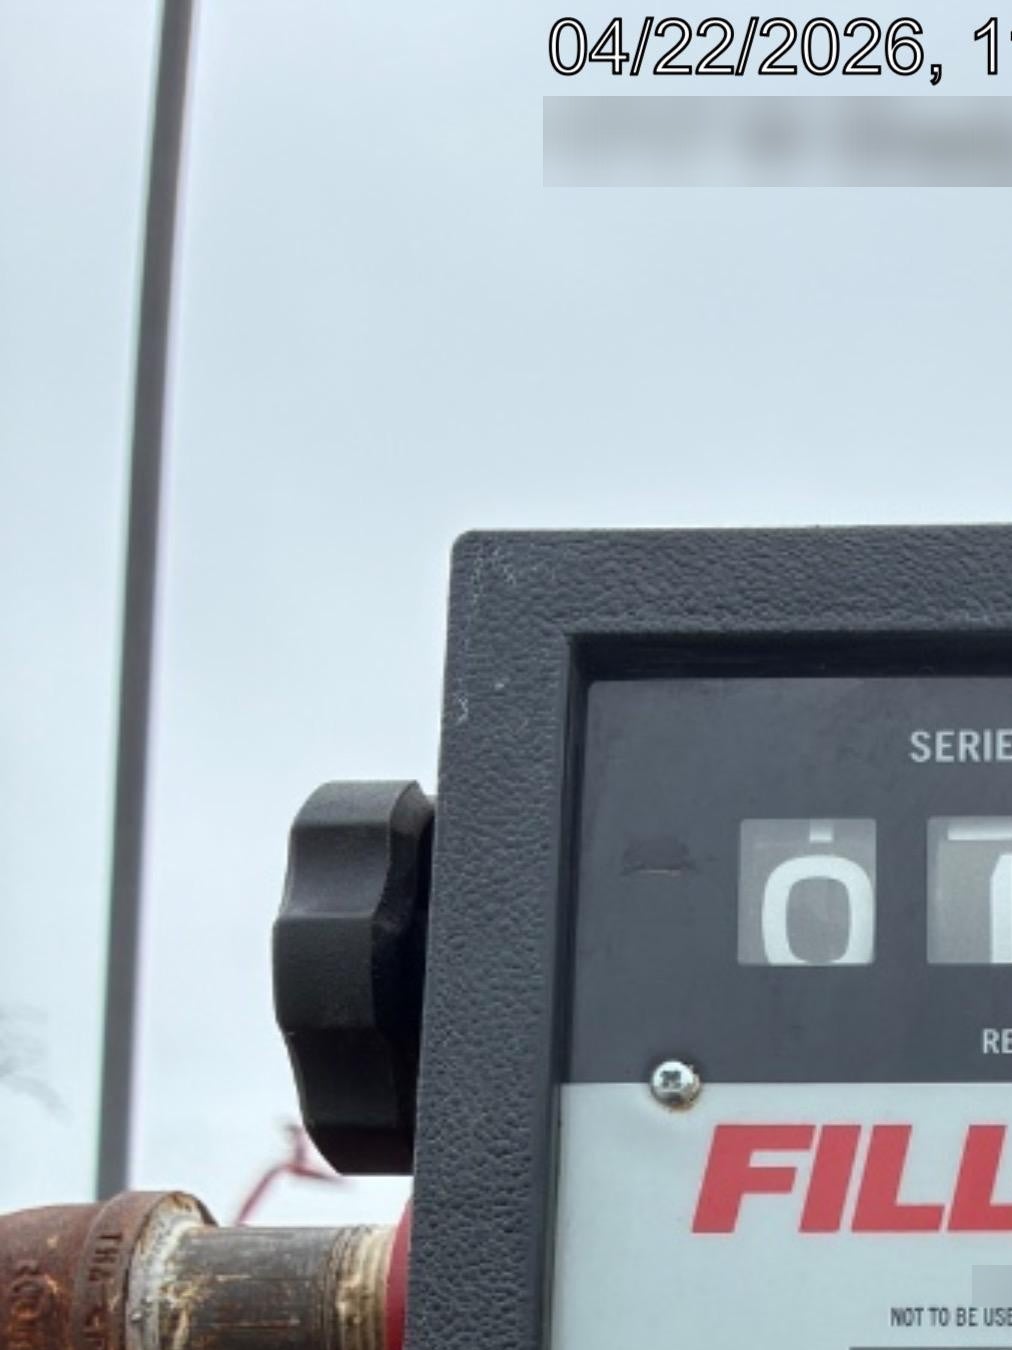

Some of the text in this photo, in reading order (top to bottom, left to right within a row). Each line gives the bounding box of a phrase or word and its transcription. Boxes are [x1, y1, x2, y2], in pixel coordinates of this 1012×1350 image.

[890, 1307, 924, 1328] NOT
[927, 1307, 950, 1328] TO
[956, 1307, 979, 1328] BE
